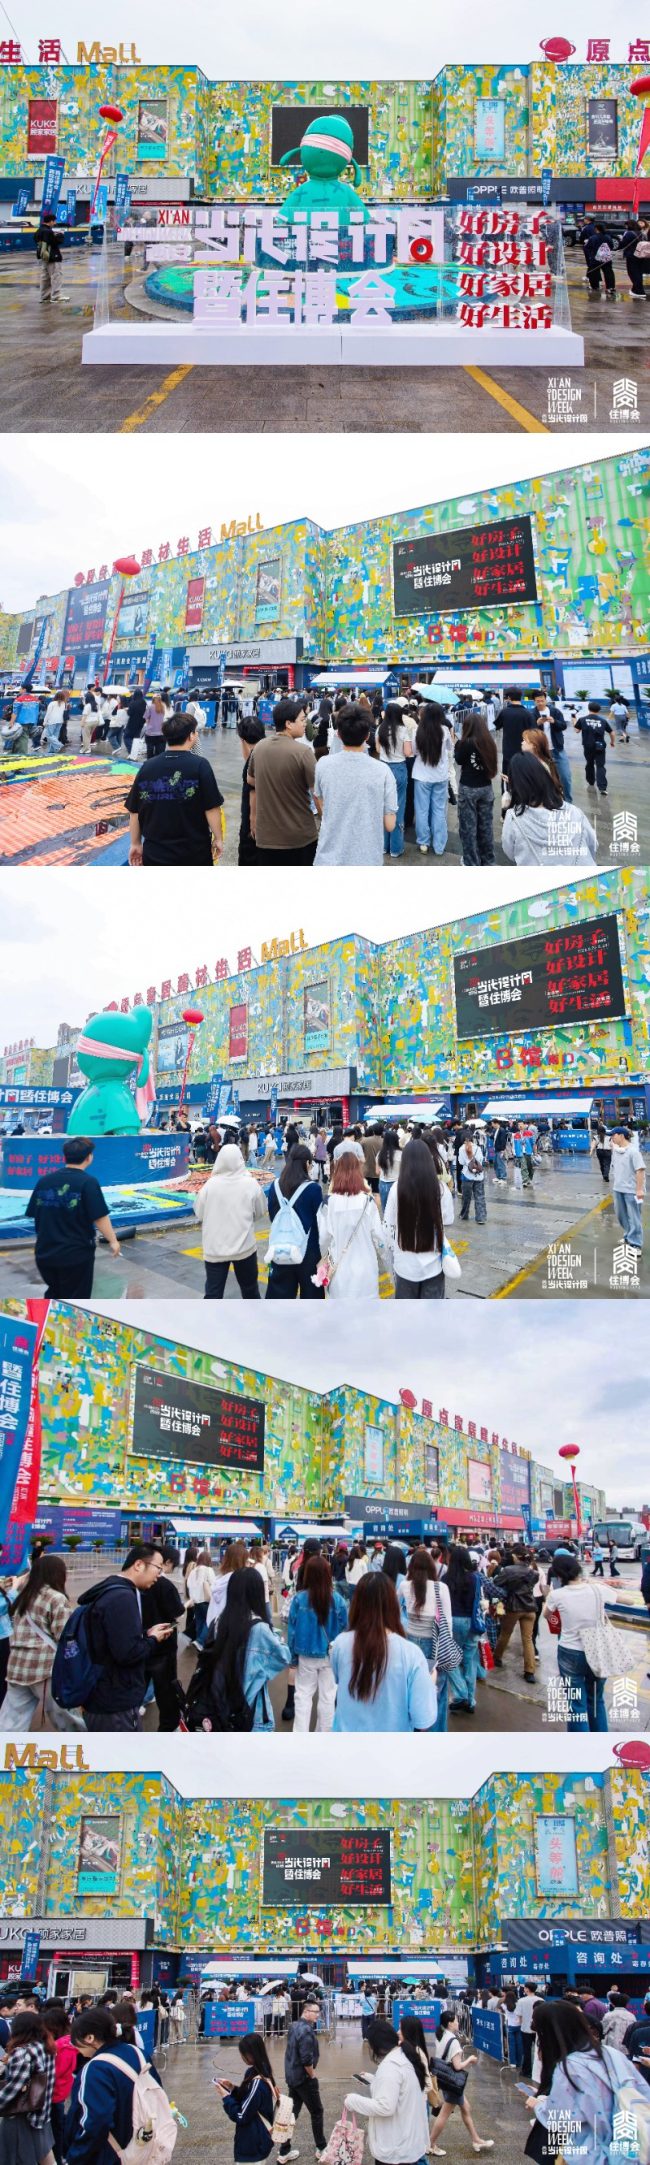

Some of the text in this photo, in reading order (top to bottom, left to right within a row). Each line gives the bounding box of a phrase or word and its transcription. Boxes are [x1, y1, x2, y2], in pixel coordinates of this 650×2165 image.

[77, 41, 141, 63] Mall
[157, 209, 190, 225] XI'AN
[459, 211, 553, 236] 好房子
[456, 241, 553, 266] 好设计
[457, 272, 553, 298] 好家居
[457, 302, 553, 330] 好生活
[220, 512, 264, 541] Mall
[261, 929, 309, 962] Mall
[4, 1743, 90, 1770] Mall
[576, 1951, 623, 1965] 咨询处
